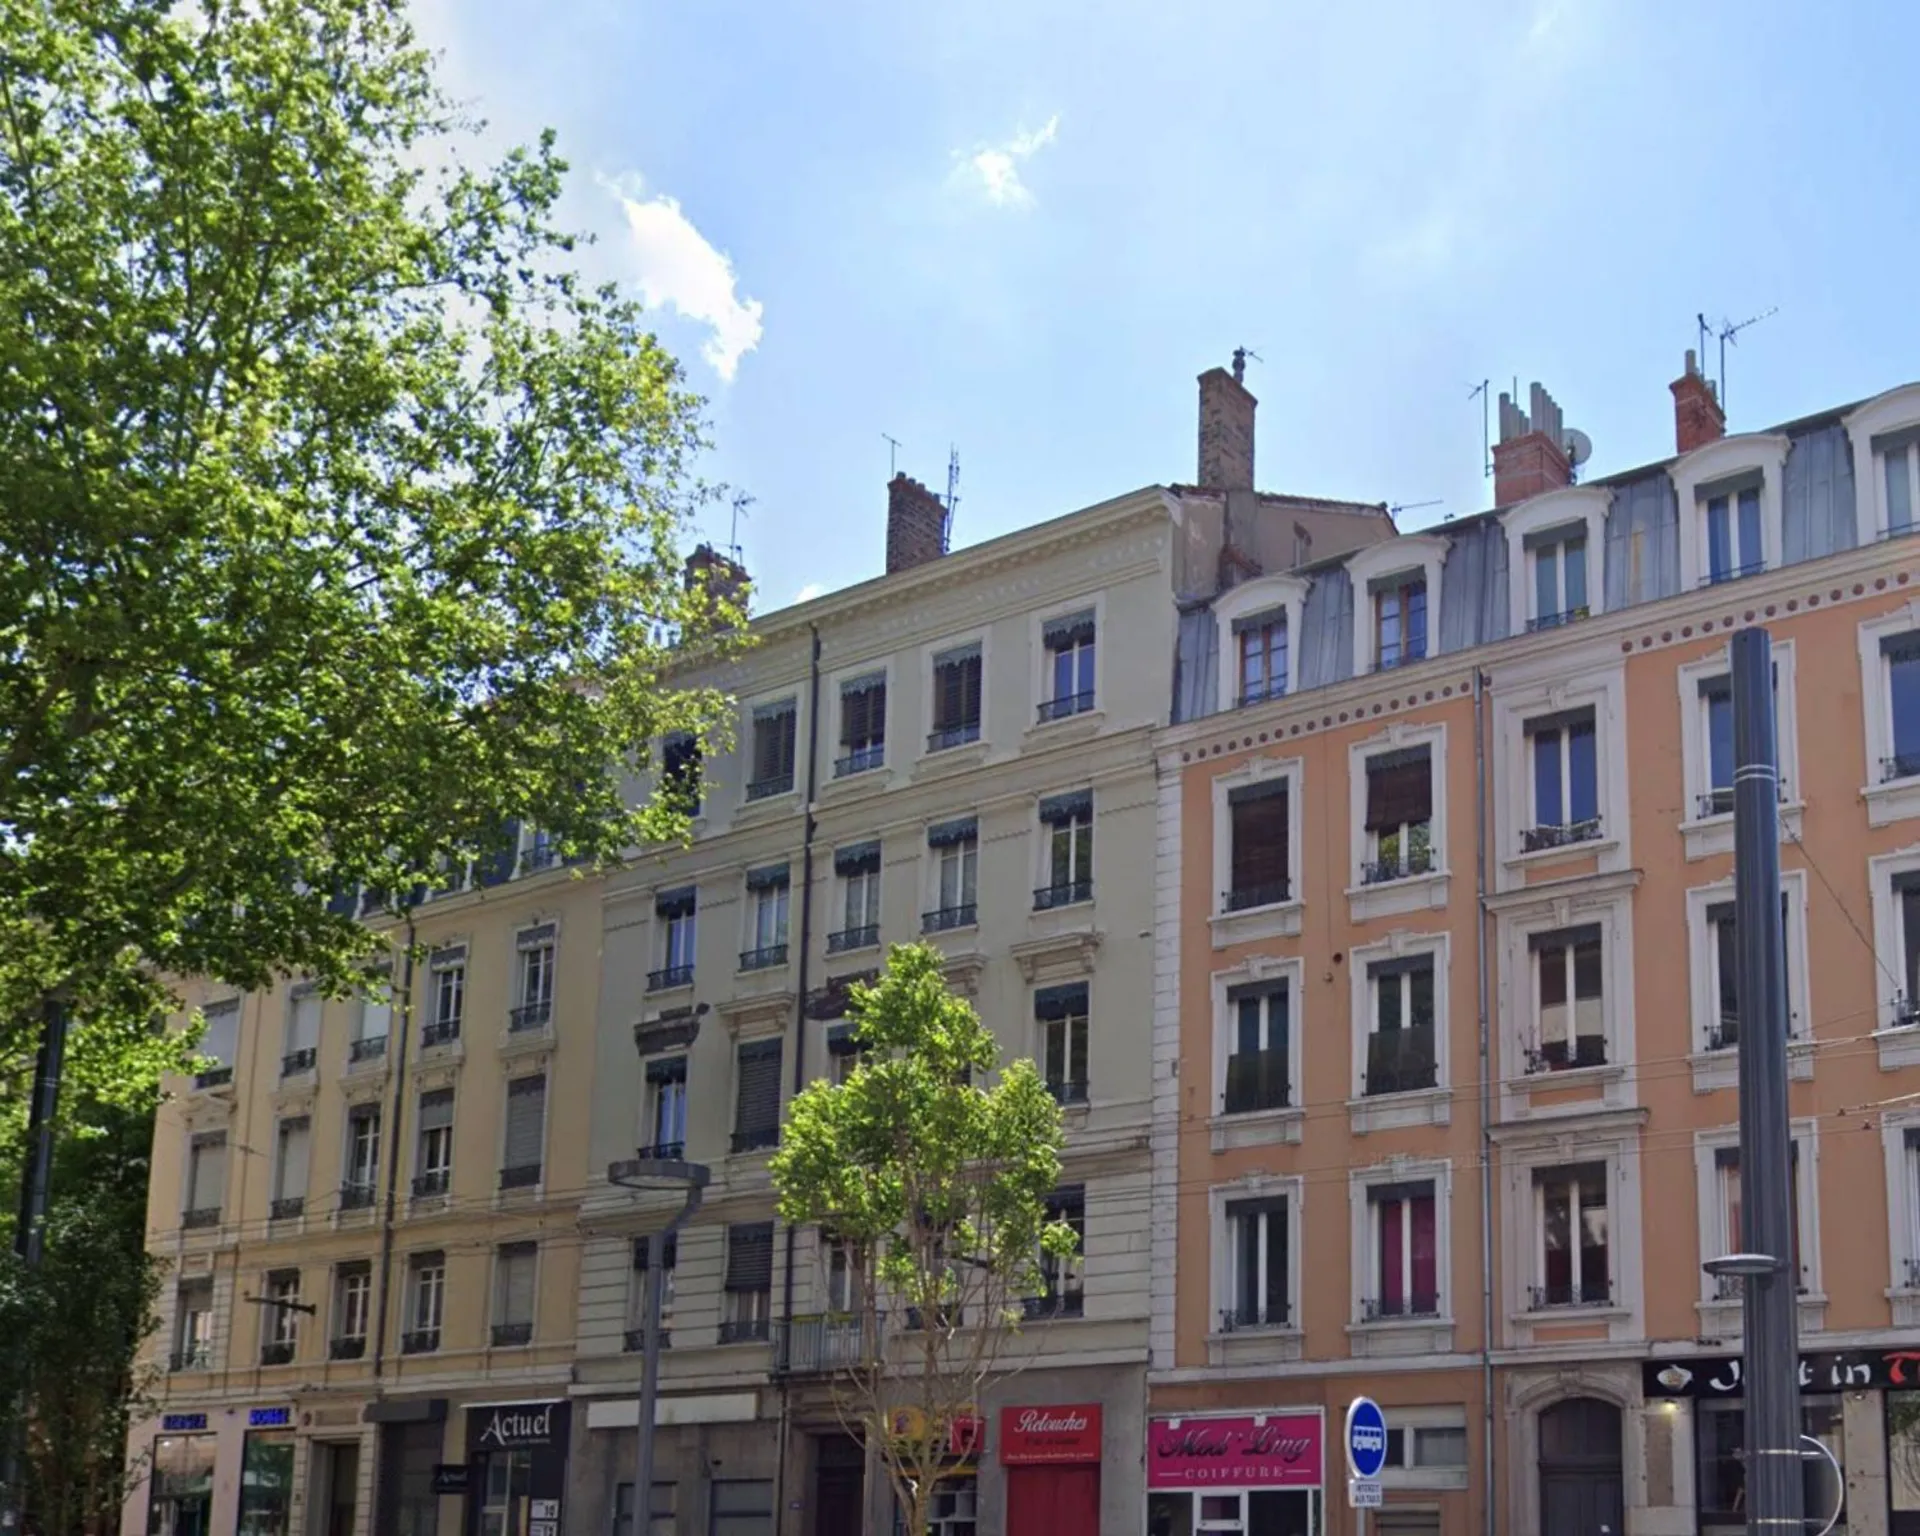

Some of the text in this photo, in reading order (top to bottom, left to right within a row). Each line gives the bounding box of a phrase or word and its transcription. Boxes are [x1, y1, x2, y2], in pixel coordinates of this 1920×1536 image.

[1709, 1351, 1920, 1391] Jt in T
[480, 1404, 554, 1446] Actuel
[1013, 1409, 1088, 1433] Retouches
[1184, 1466, 1283, 1480] COIFFURE
